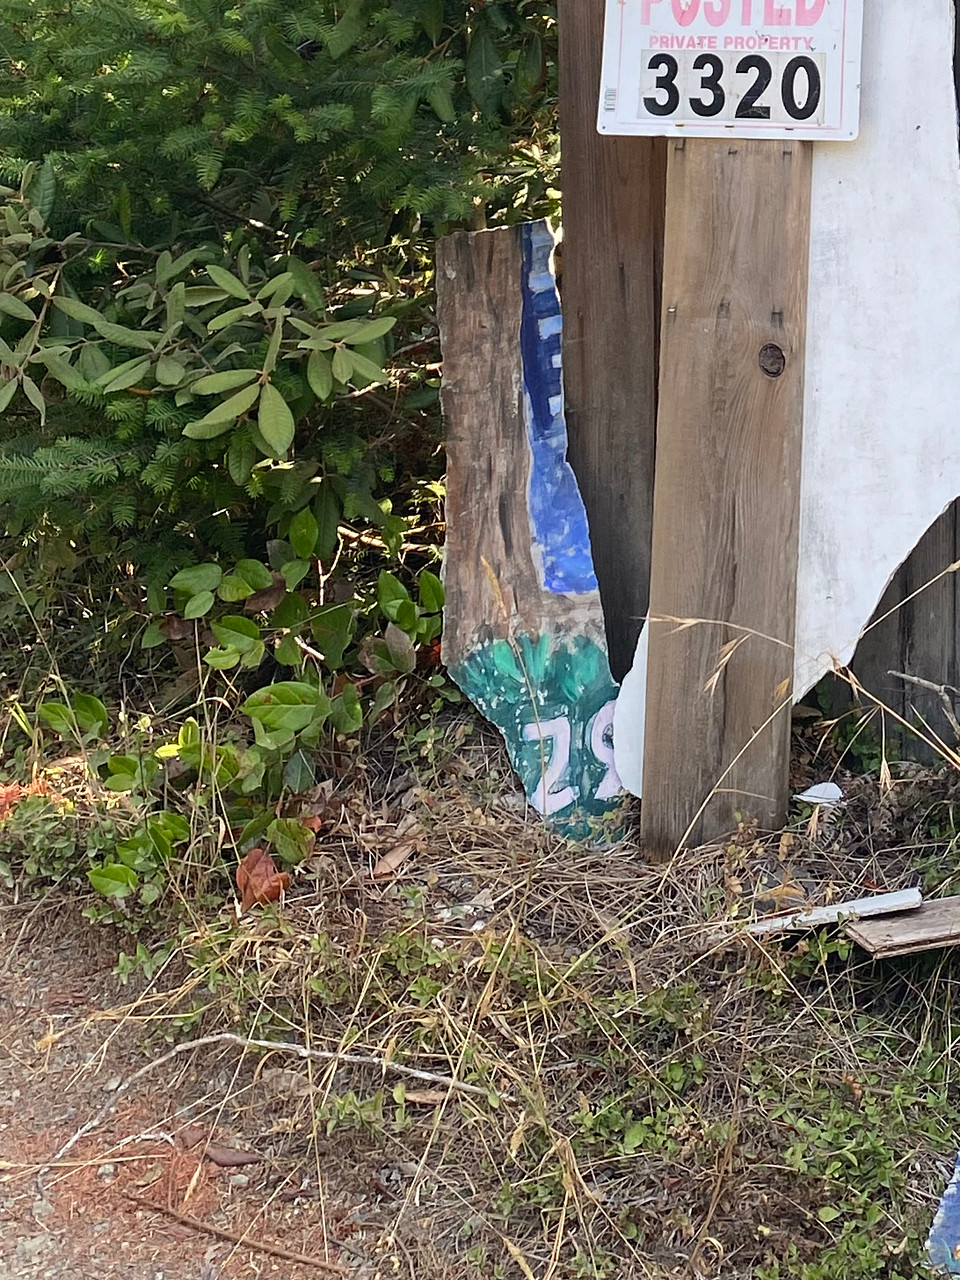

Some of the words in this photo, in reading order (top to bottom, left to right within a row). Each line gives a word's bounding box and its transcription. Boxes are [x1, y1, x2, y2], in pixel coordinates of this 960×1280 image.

[649, 34, 717, 50] PRIVATE
[723, 35, 814, 51] PROPERTY
[643, 52, 821, 121] 3320
